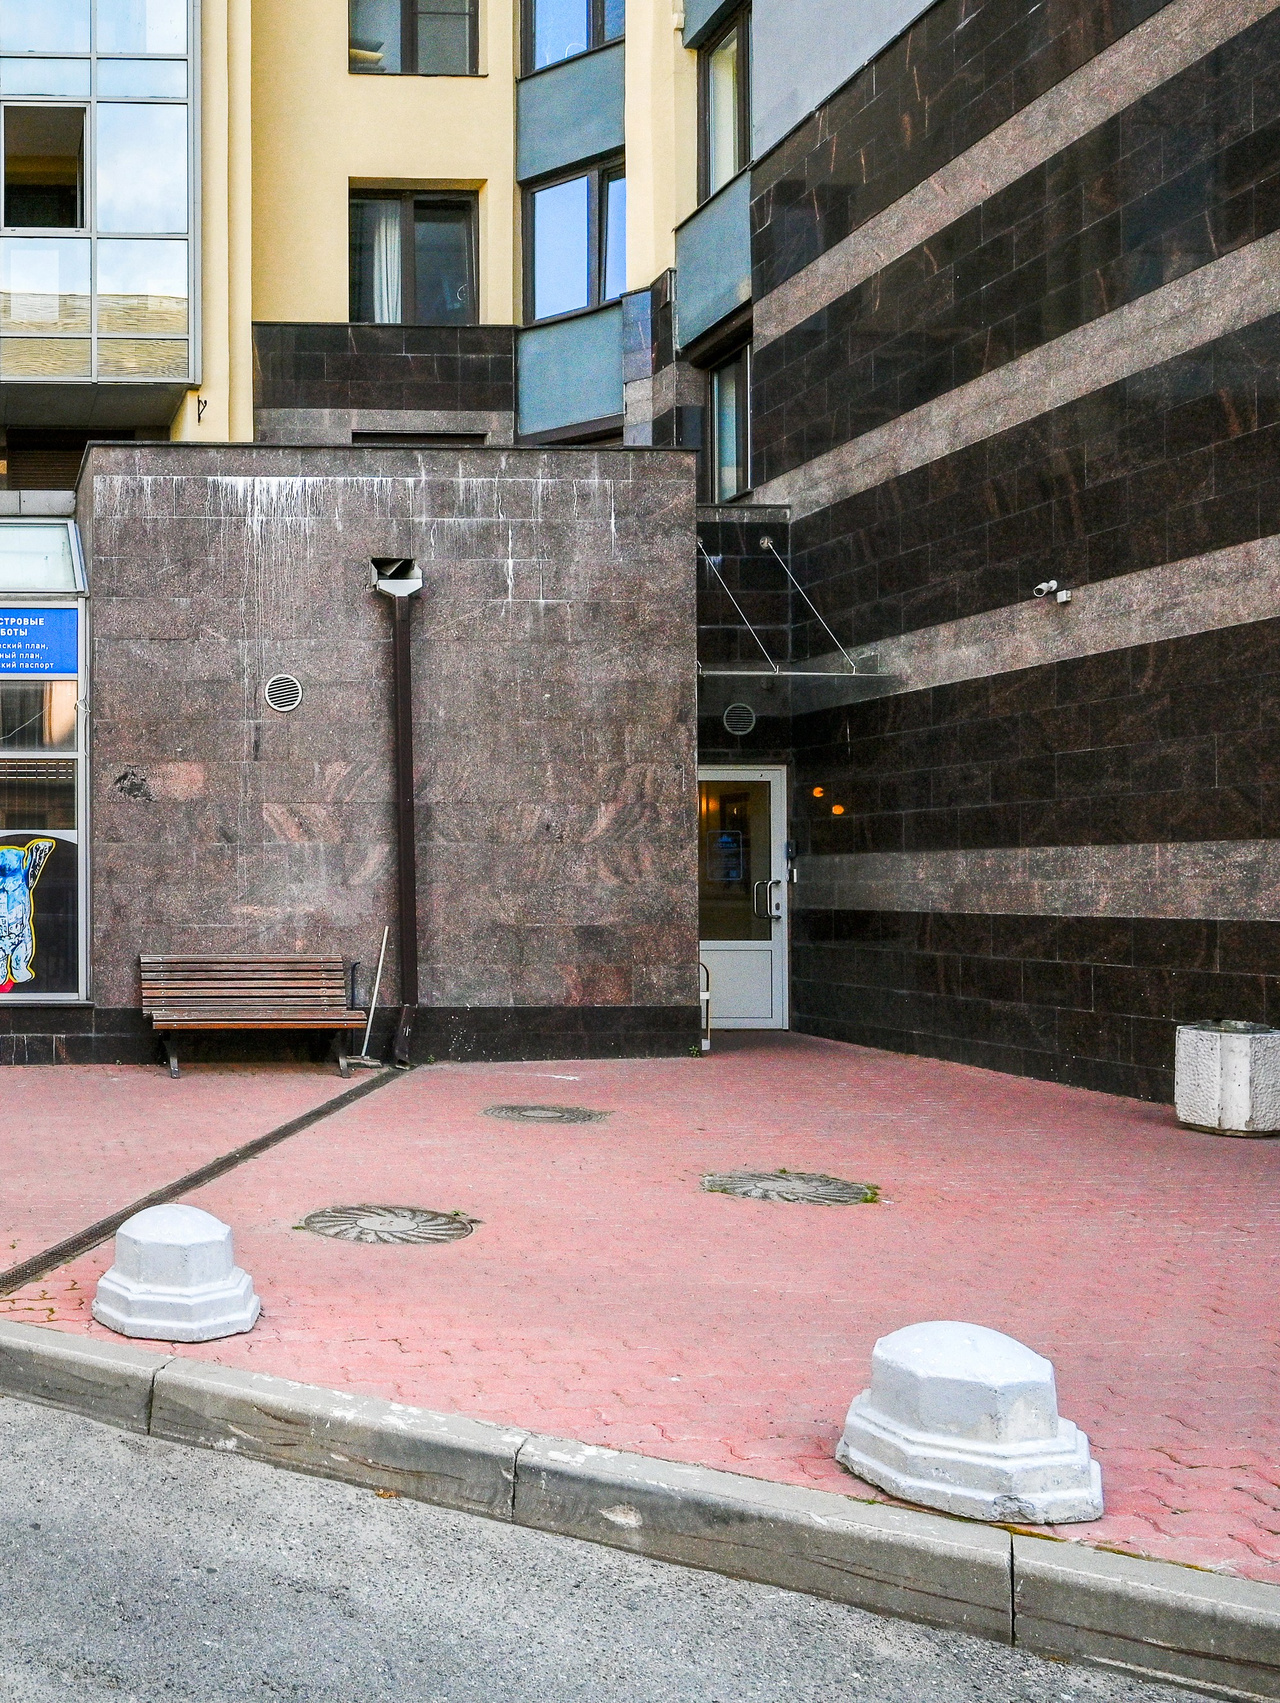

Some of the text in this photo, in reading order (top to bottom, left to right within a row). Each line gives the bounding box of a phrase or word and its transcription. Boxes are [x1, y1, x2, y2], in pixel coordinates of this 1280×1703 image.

[25, 642, 49, 650] план,
[19, 652, 43, 660] план,
[19, 662, 55, 670] паспорт
